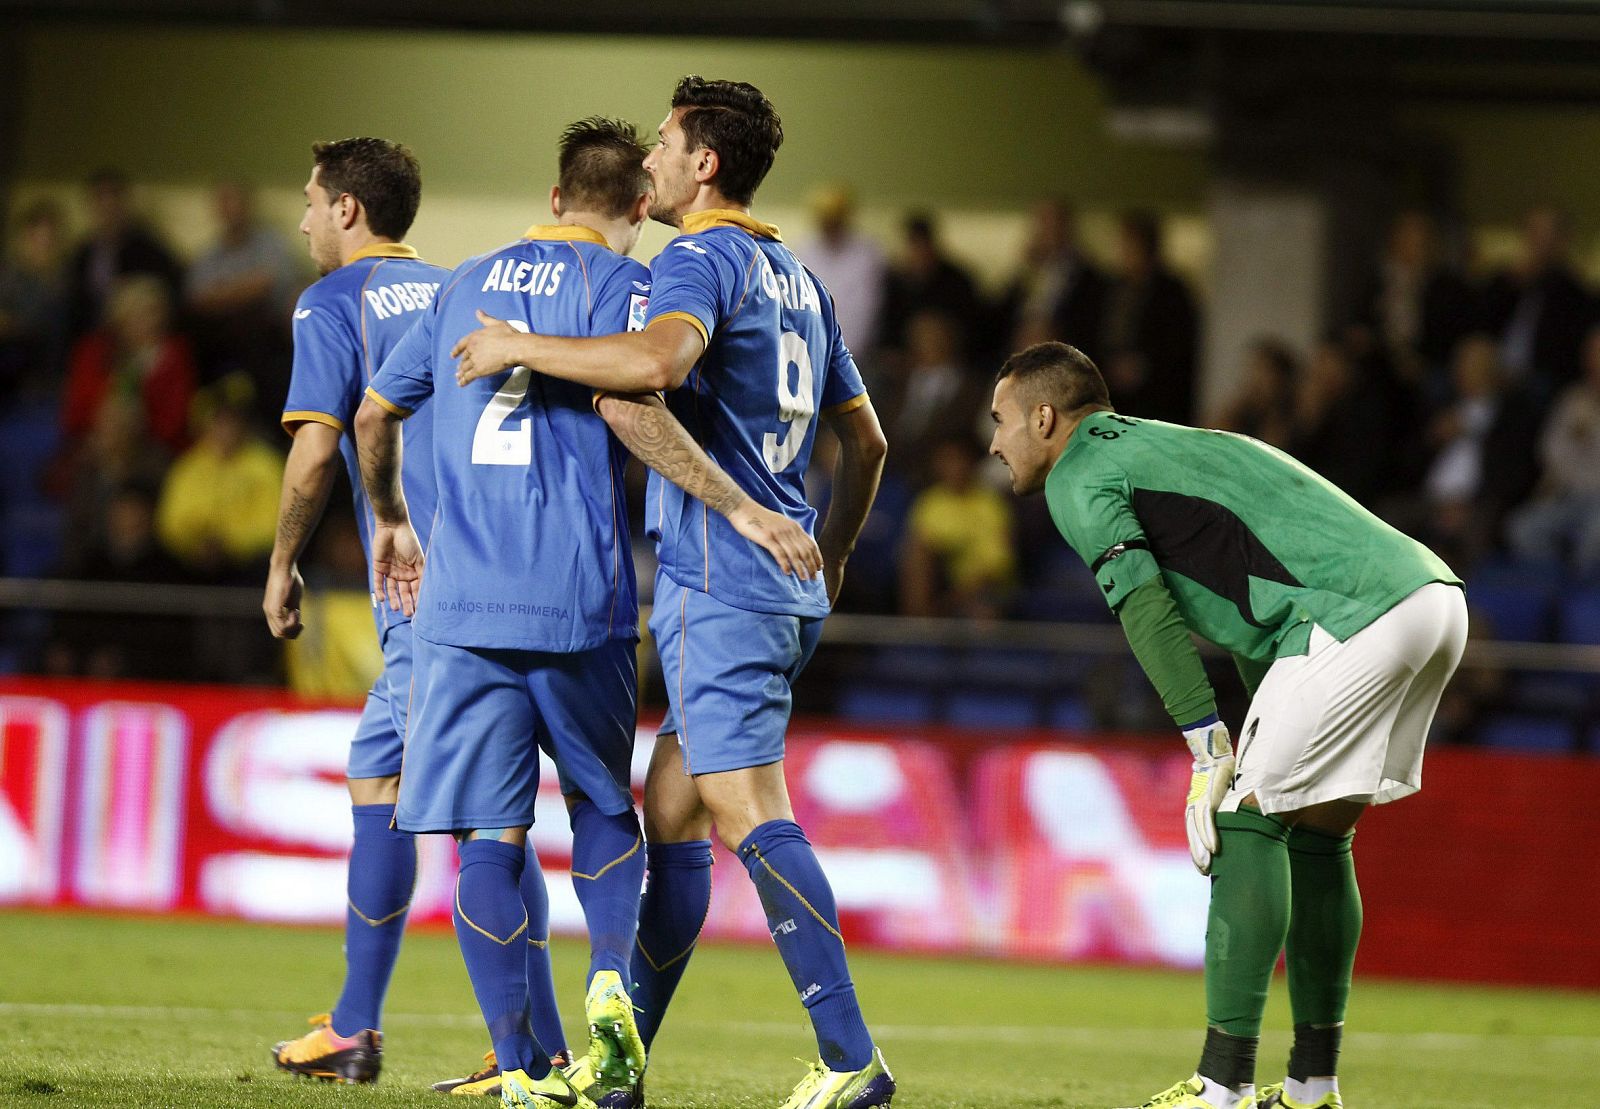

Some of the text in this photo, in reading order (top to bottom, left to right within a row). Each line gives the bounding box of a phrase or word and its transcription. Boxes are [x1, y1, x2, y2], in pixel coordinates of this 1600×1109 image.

[481, 258, 565, 297] ALEXIS
[472, 320, 532, 465] 2
[762, 331, 815, 474] 9
[438, 600, 569, 620] 10 AÑOS EN PRIMERA
